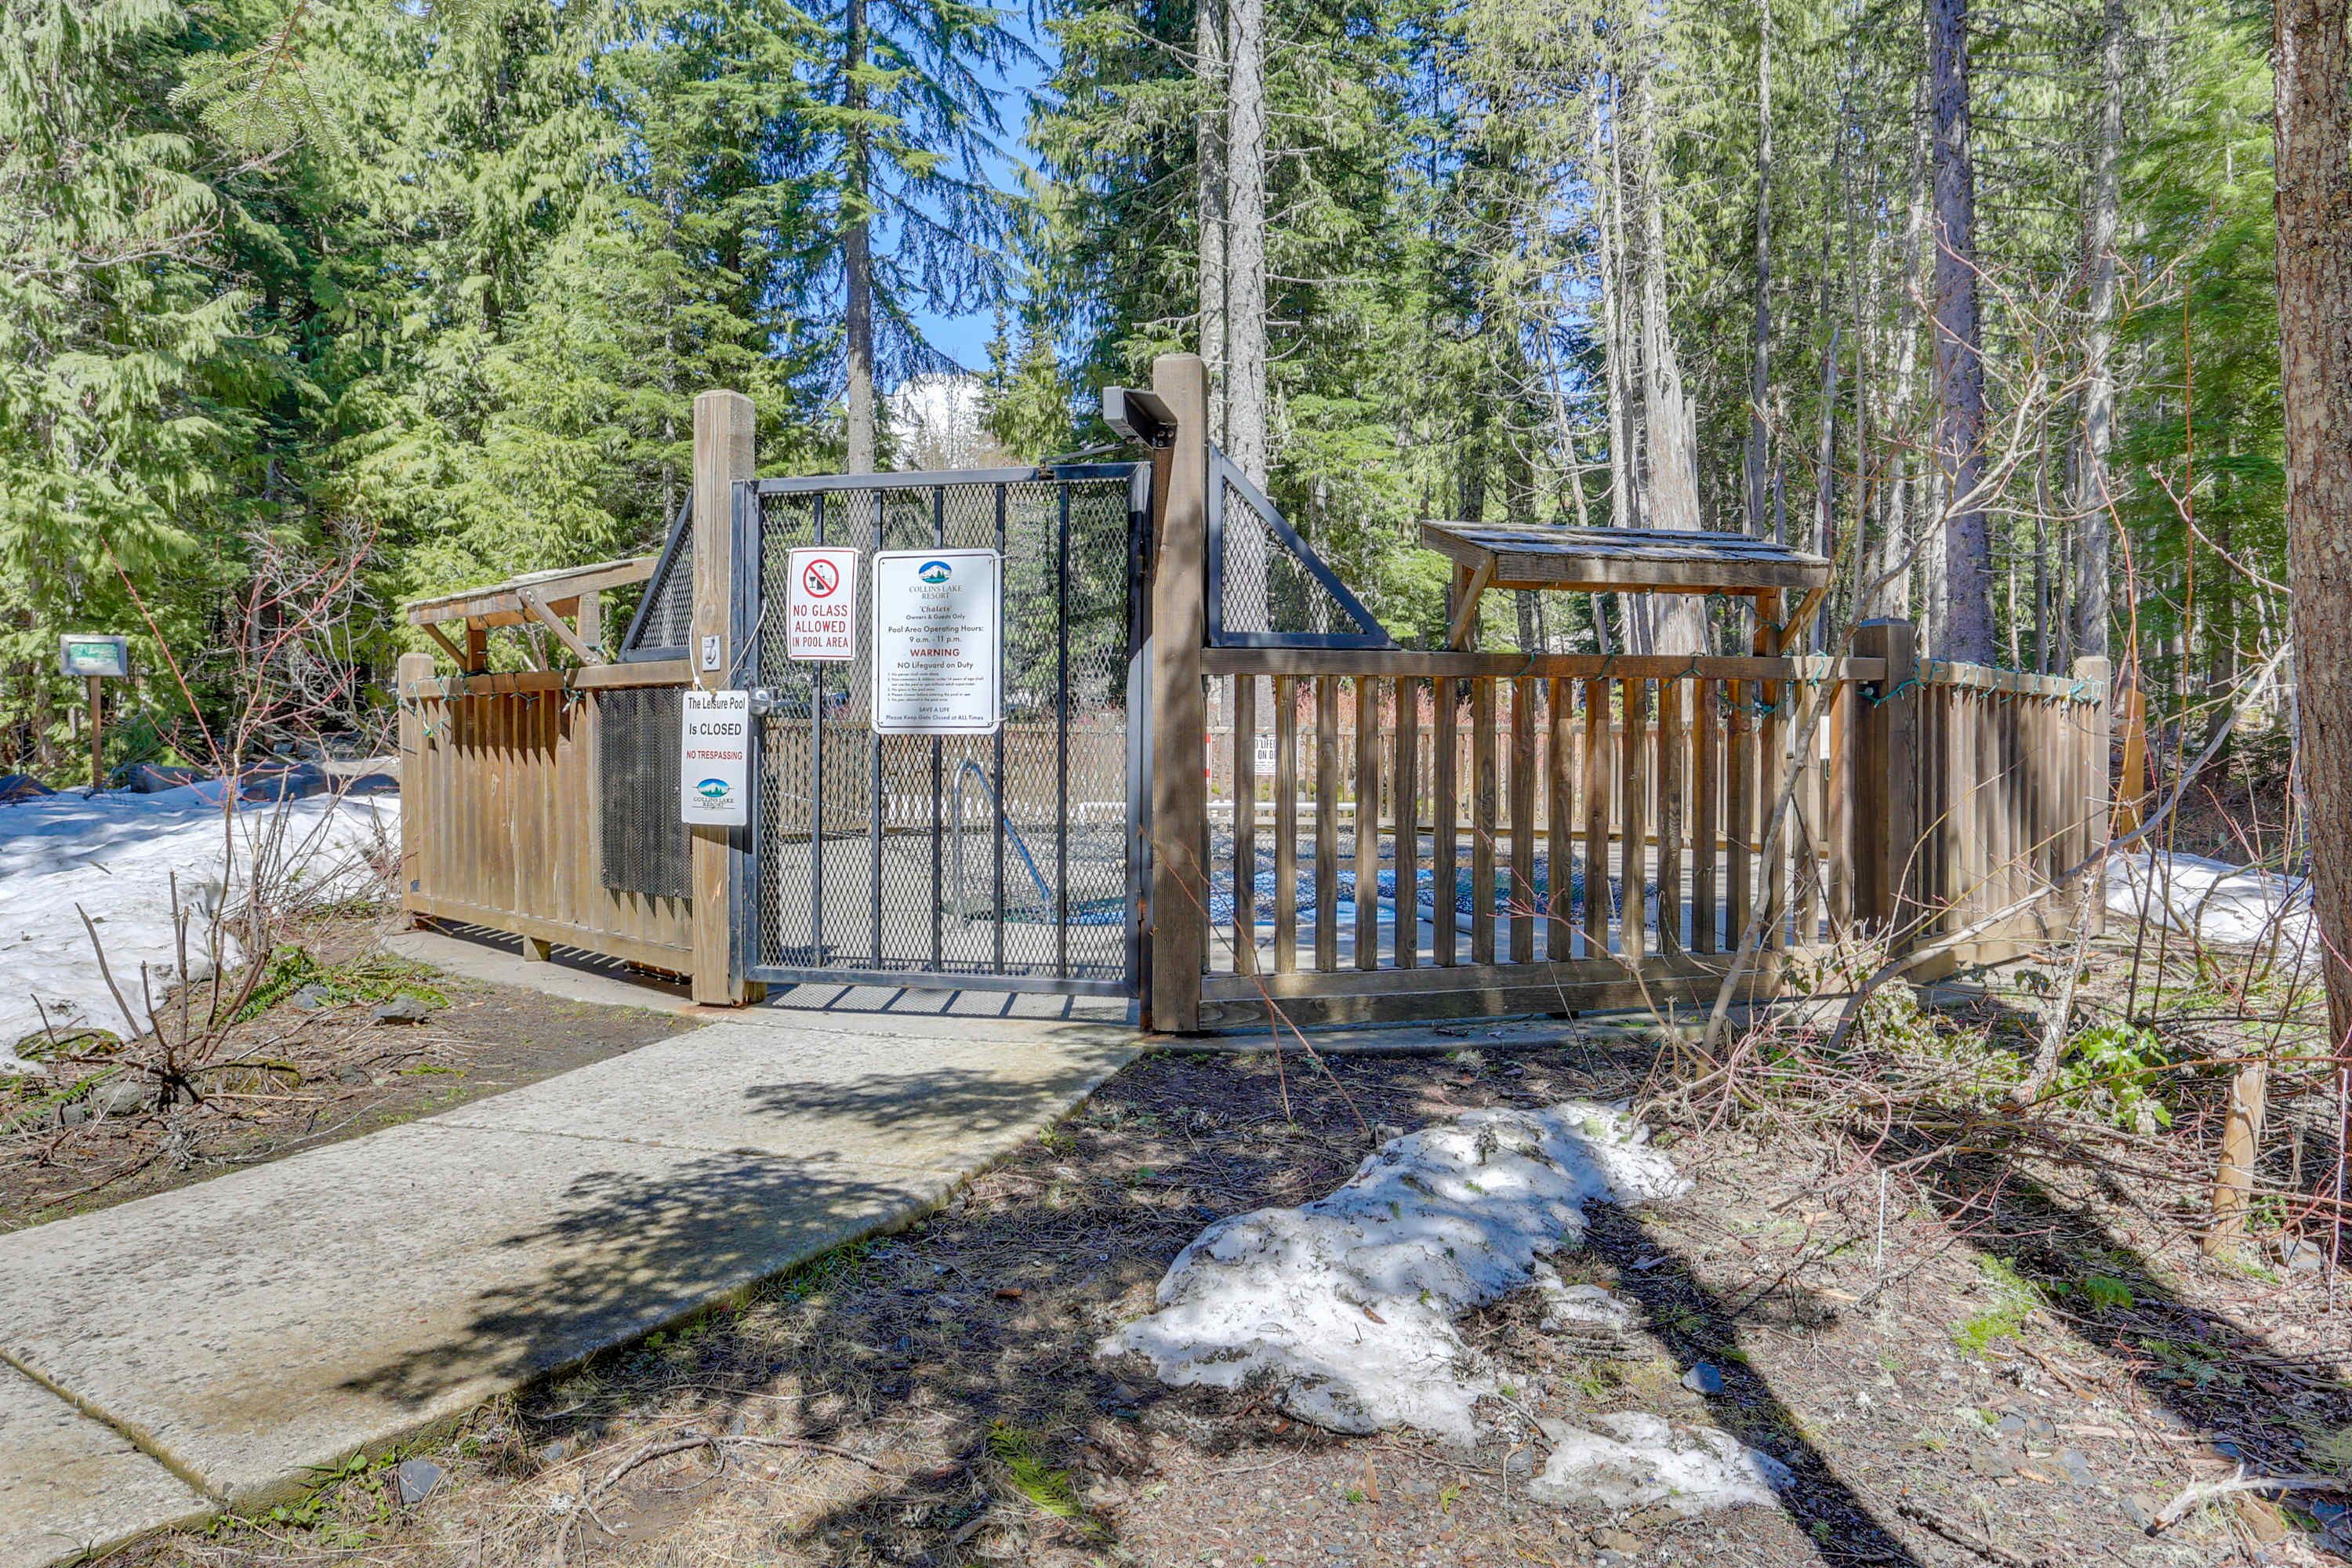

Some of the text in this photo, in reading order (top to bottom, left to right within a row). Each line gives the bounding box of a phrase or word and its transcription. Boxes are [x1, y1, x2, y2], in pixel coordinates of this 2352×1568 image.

[793, 604, 848, 616] NO GLASS
[795, 621, 846, 633] ALLOWED
[924, 626, 959, 634] Operating
[793, 637, 848, 648] IN POOL AREA
[910, 648, 960, 657] WARNING
[912, 661, 945, 670] Lifeguard
[957, 661, 974, 670] Duty
[688, 697, 746, 710] The Leisure Pool
[689, 723, 742, 735] Is CLOSED
[687, 750, 742, 760] NO TRESPASSING
[1258, 750, 1266, 759] ON
